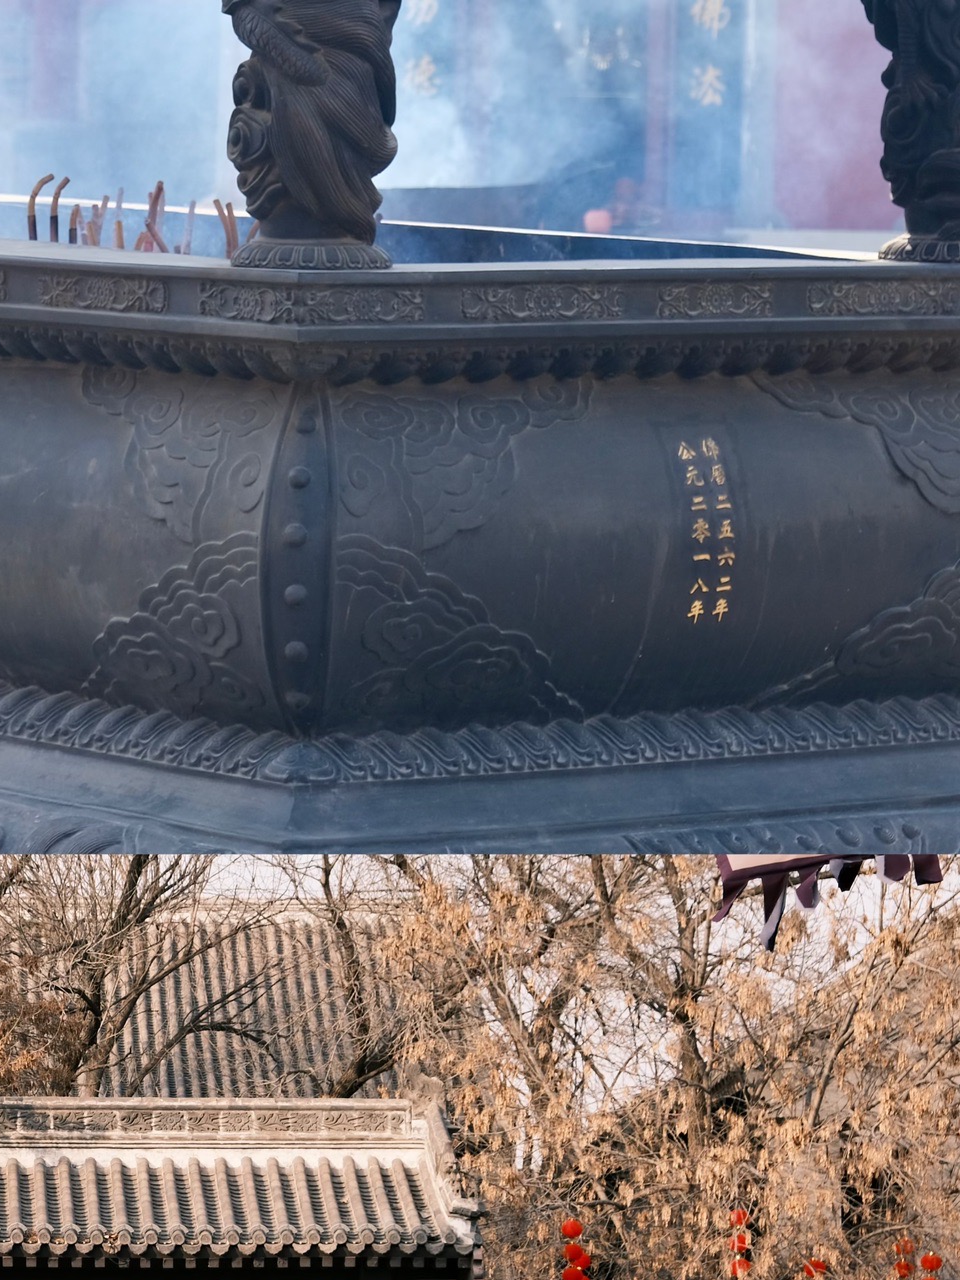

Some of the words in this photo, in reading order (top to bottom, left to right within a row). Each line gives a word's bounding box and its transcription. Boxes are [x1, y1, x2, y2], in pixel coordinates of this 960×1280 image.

[678, 441, 712, 624] 公元二零一八年
